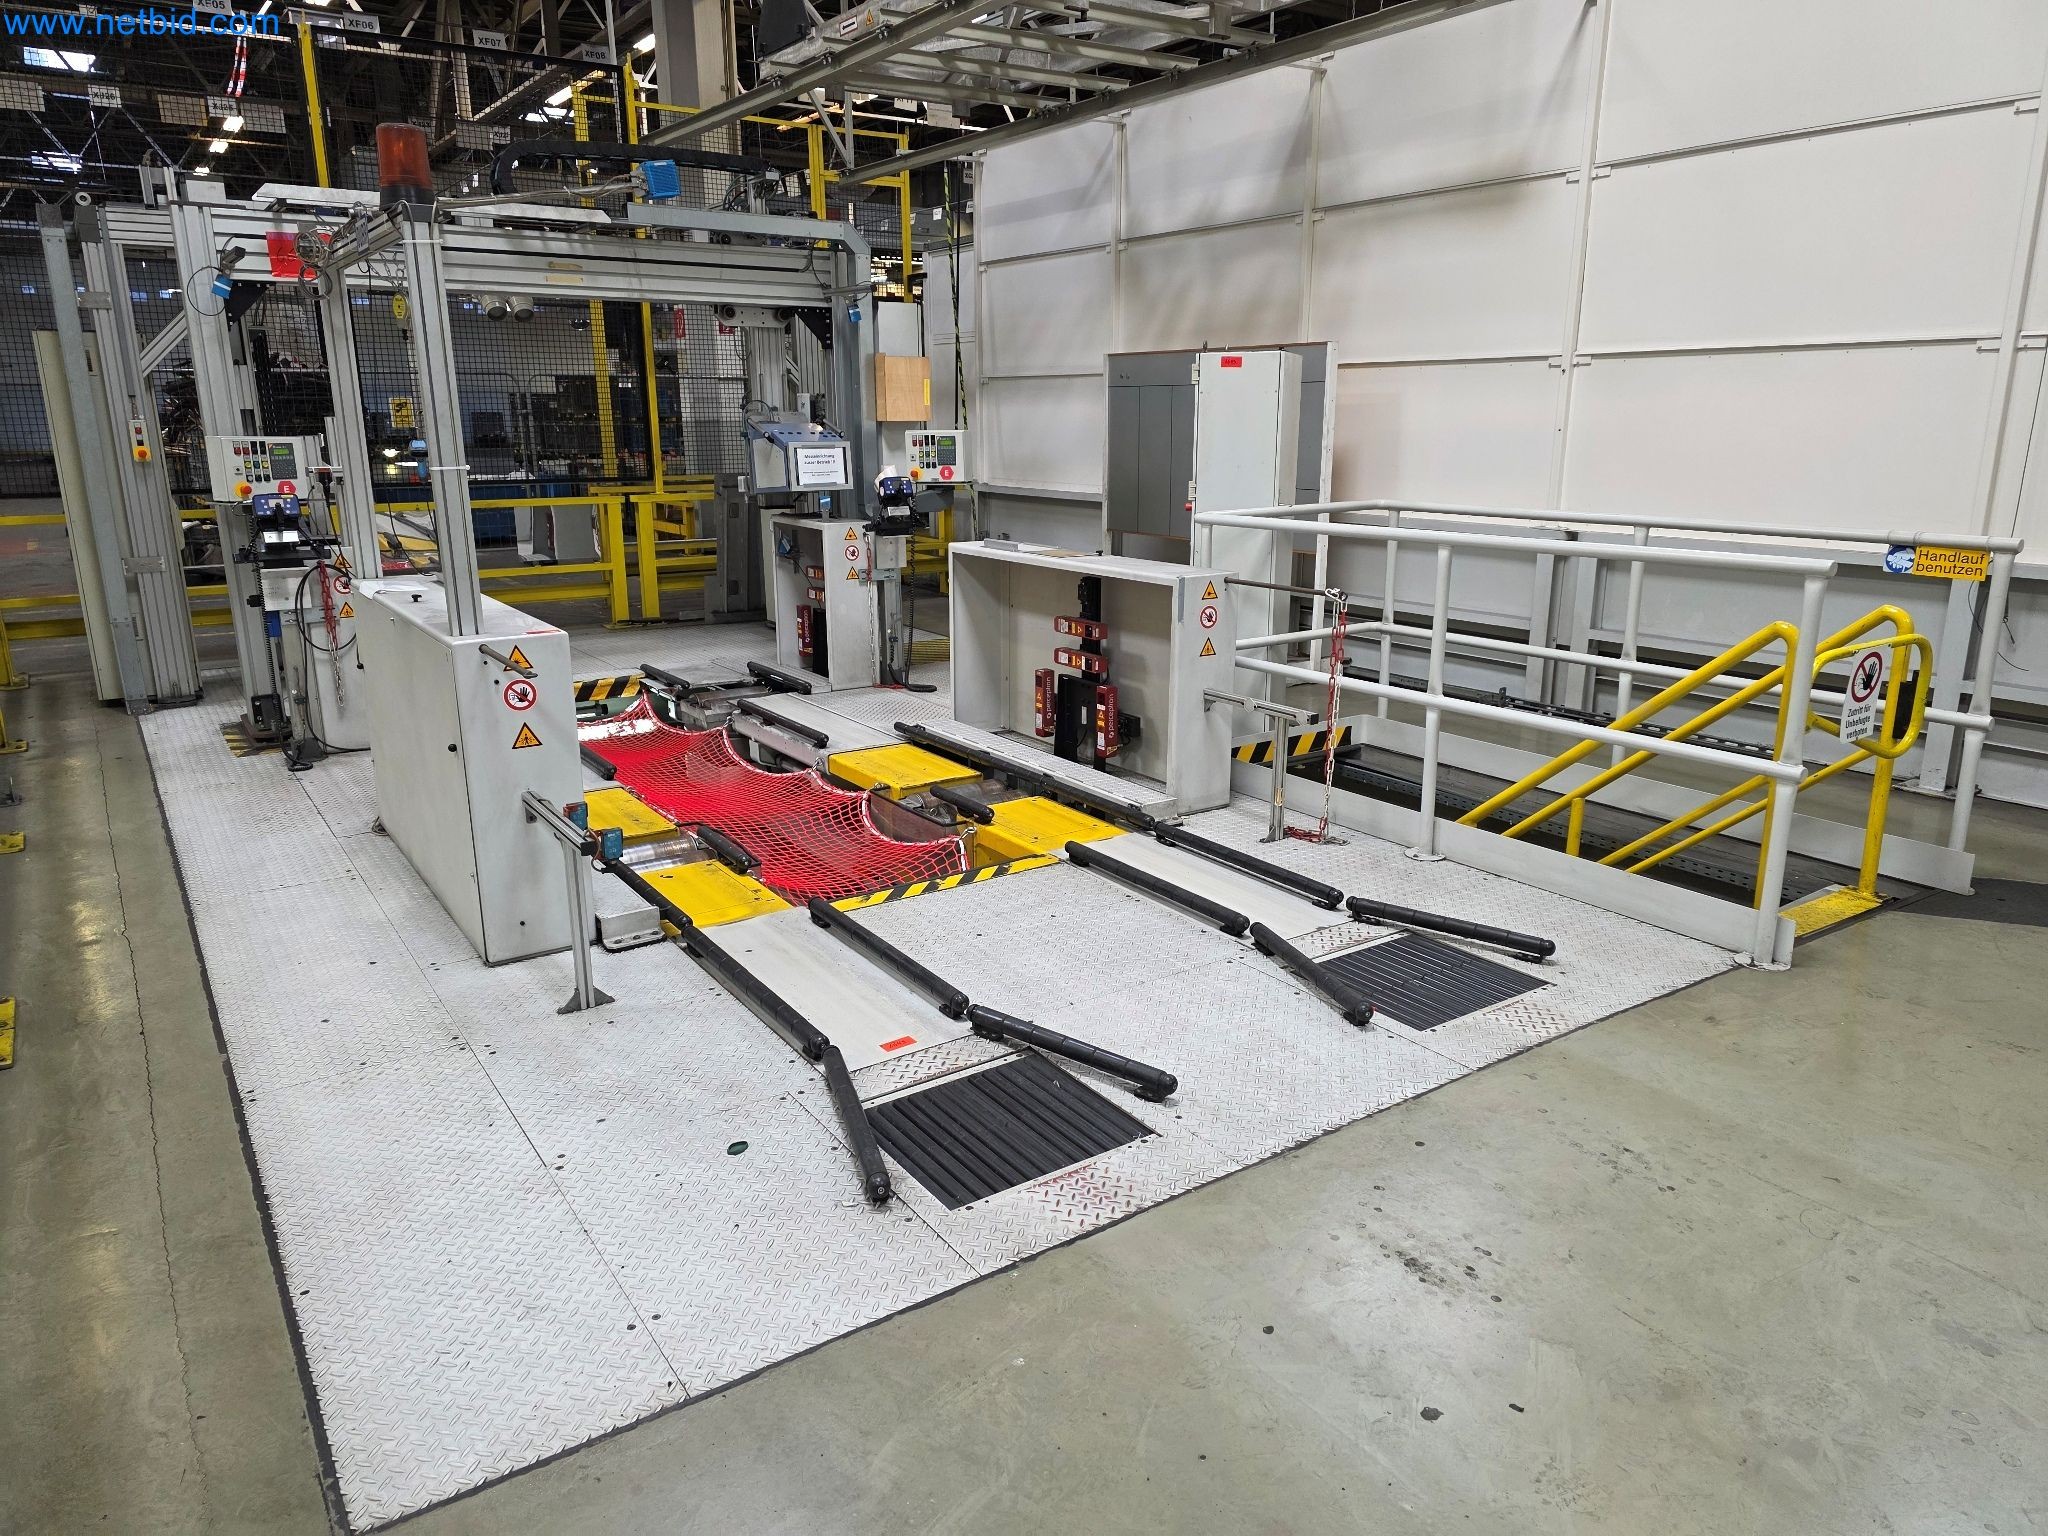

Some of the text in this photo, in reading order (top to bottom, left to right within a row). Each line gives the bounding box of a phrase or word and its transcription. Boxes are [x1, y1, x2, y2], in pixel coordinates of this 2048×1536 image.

[348, 19, 374, 30] XF06
[478, 37, 501, 47] XF07
[585, 50, 606, 60] XF08
[944, 469, 950, 477] E
[283, 485, 290, 493] E
[1918, 549, 1986, 565] Handlauf
[1915, 560, 1983, 577] benutzen
[1847, 704, 1872, 718] Zutritt für
[1845, 715, 1871, 729] Unbefugte
[1846, 727, 1868, 740] verboten
